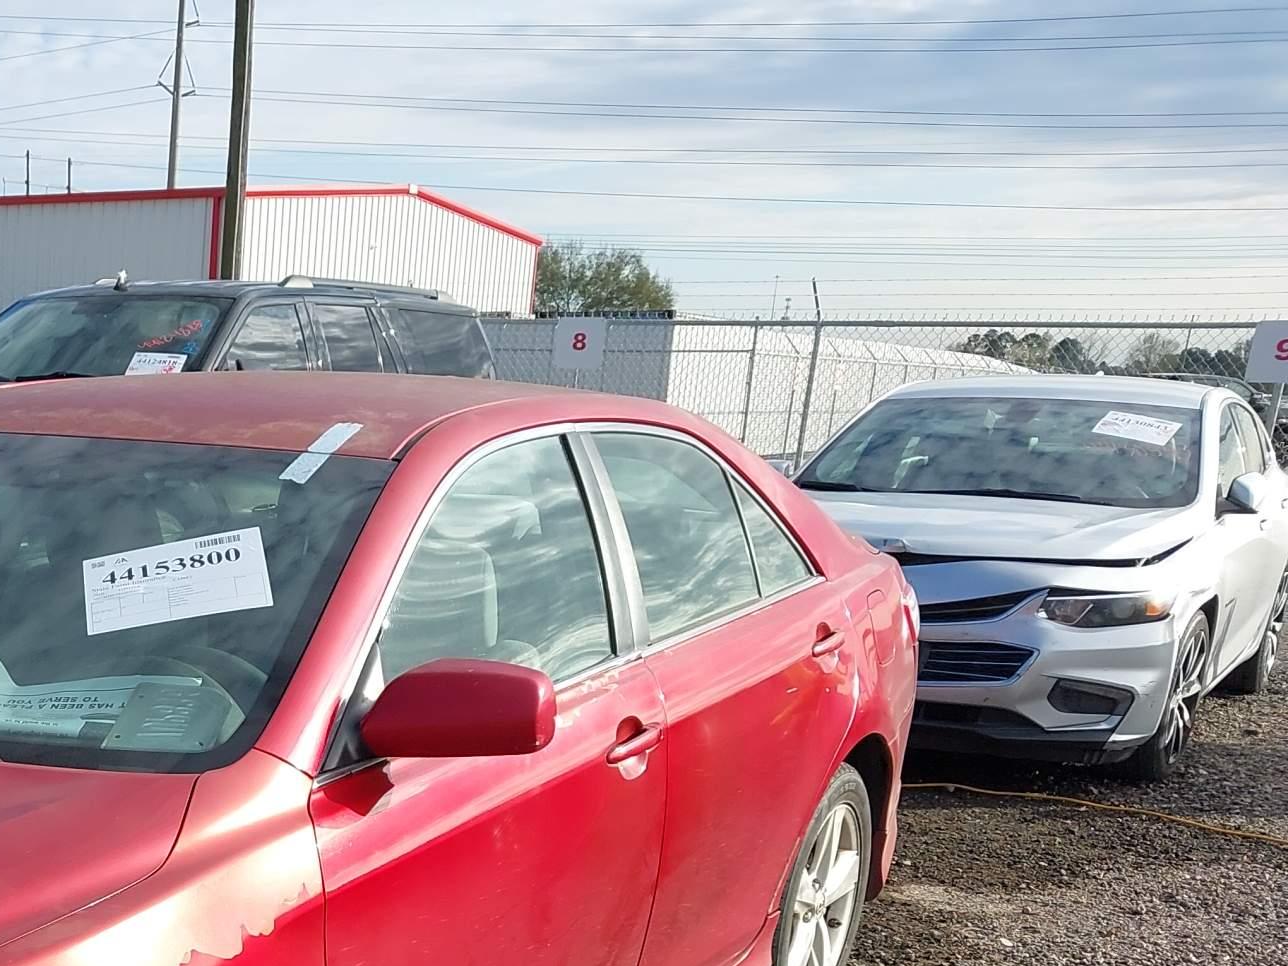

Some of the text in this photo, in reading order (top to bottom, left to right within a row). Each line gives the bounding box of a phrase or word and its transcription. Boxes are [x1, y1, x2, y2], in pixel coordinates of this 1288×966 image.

[572, 332, 587, 351] 8
[102, 547, 241, 585] 44153800
[38, 696, 79, 704] SERVE
[86, 702, 115, 710] HAS
